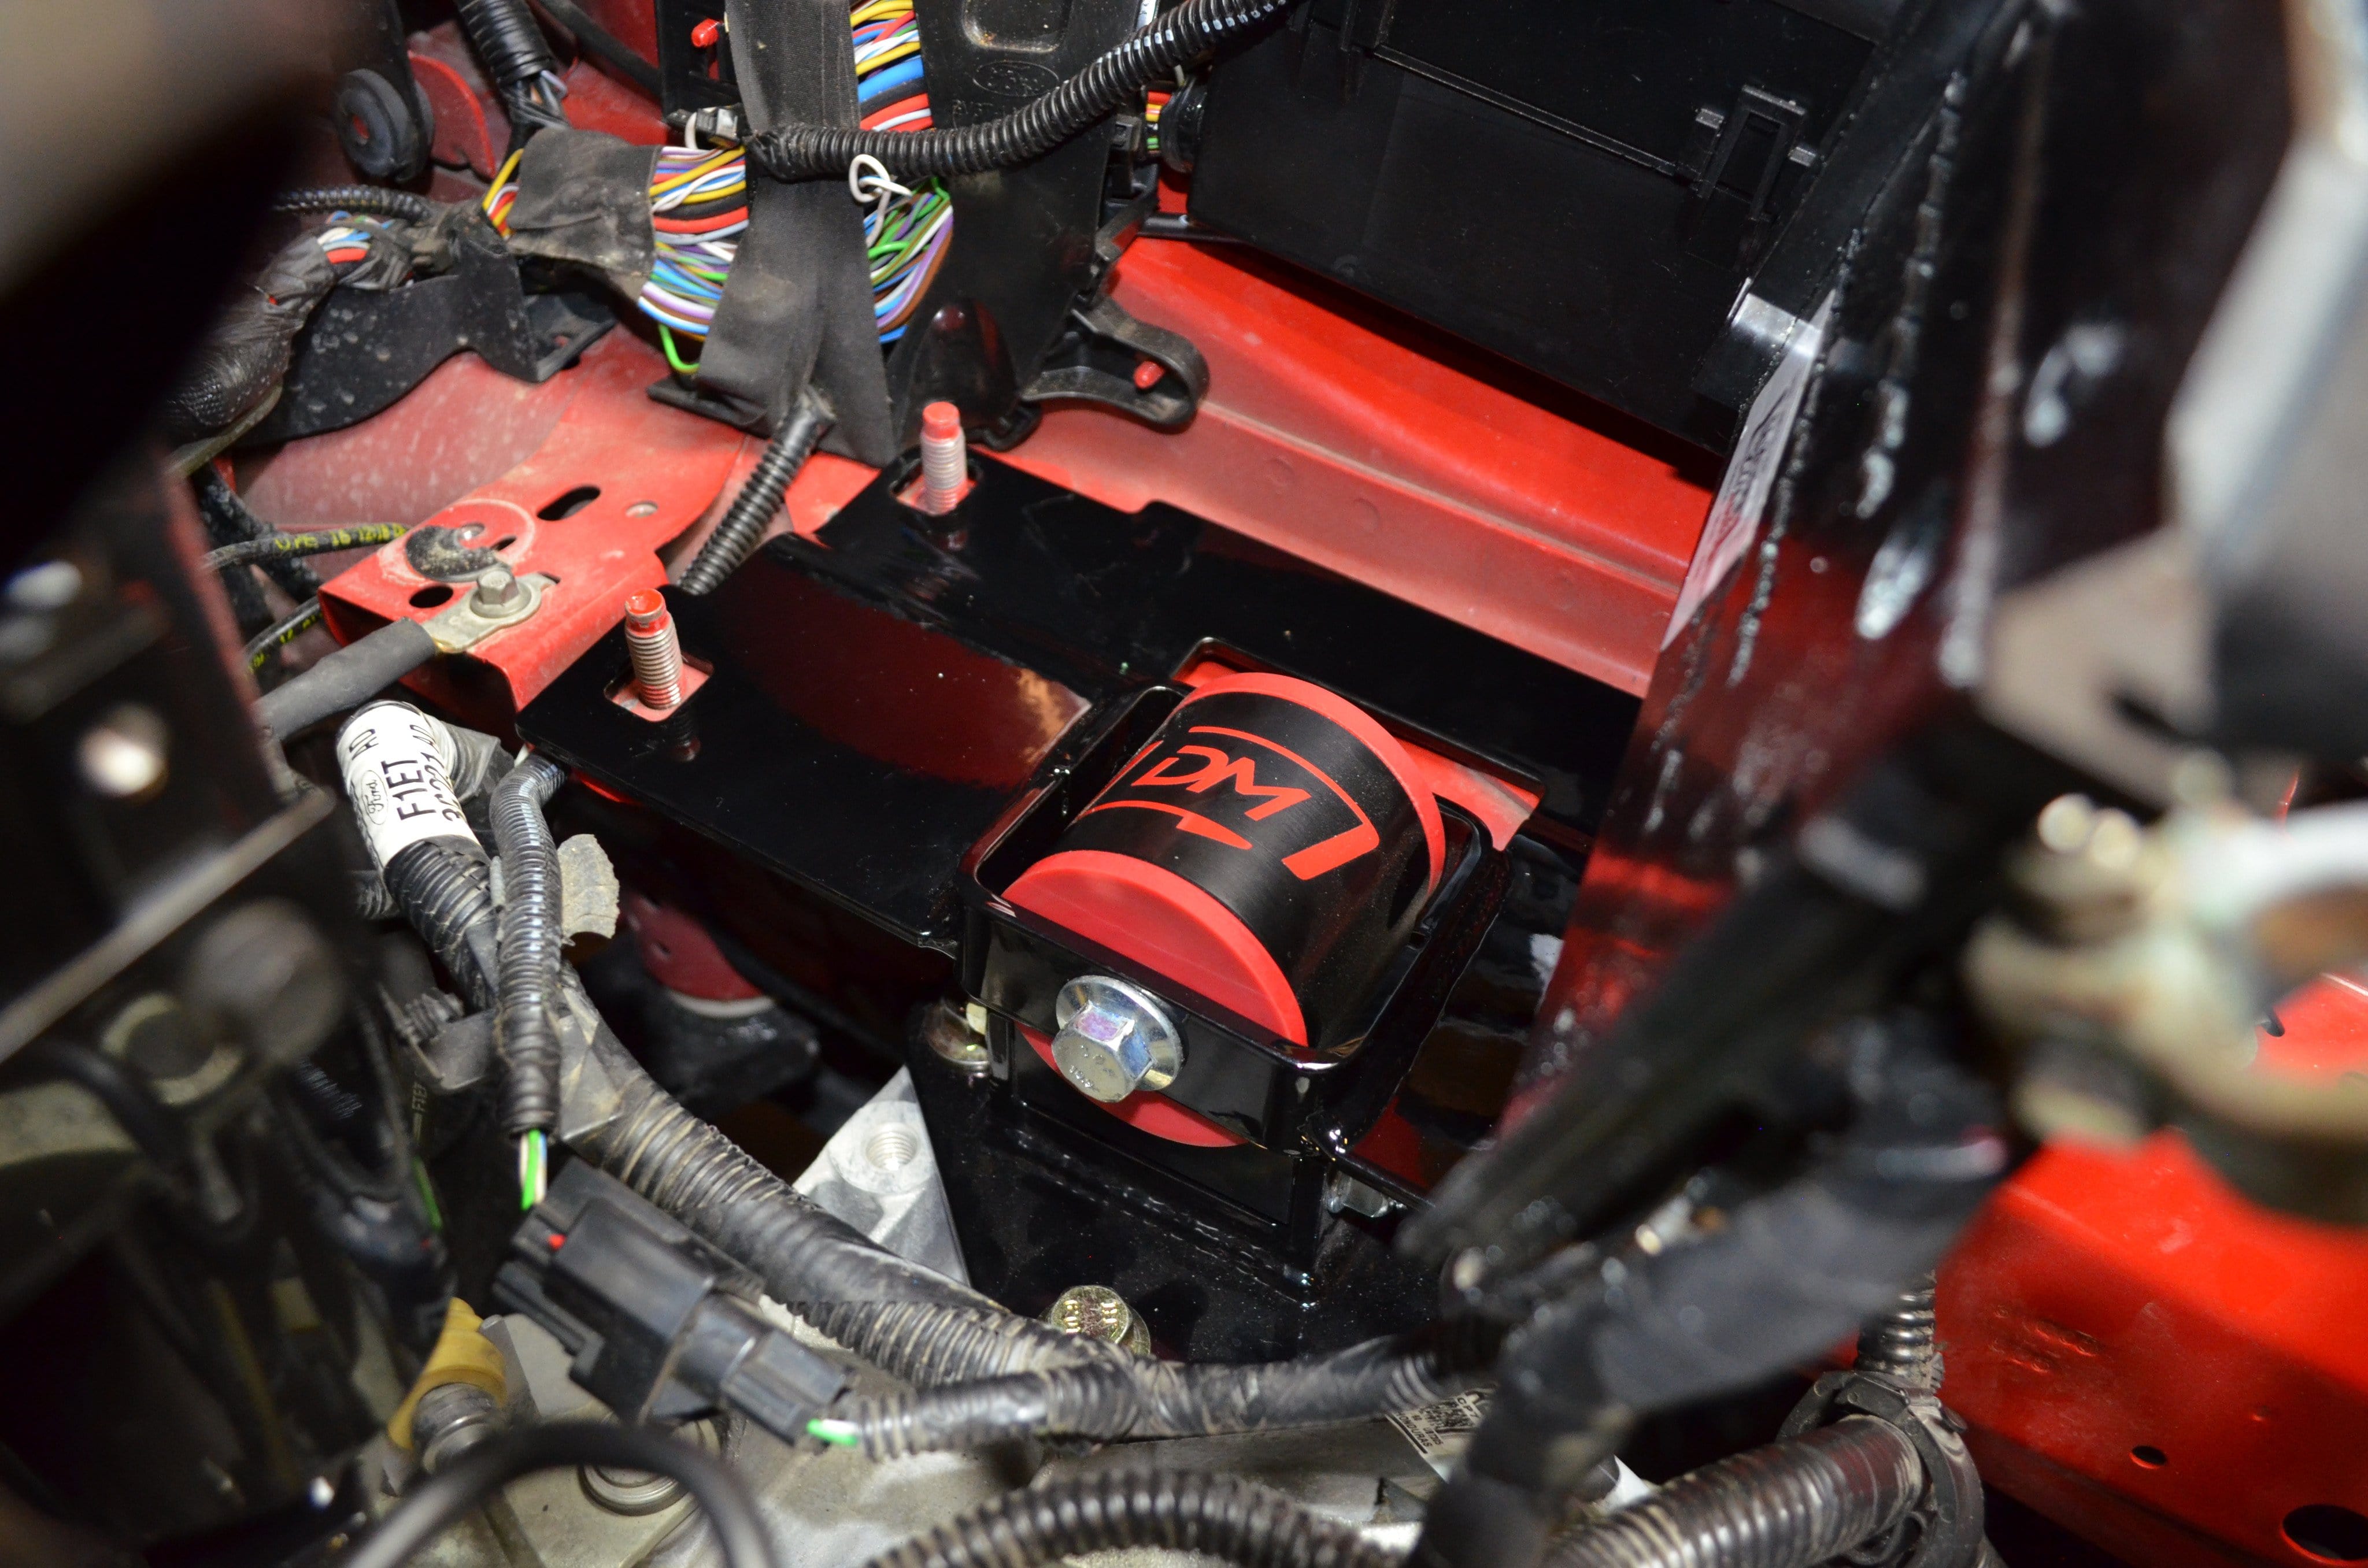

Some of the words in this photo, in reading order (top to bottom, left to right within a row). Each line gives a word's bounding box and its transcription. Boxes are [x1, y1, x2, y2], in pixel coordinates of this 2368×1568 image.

[349, 728, 379, 761] AD
[365, 779, 384, 815] Ford
[381, 759, 435, 821] F1ET
